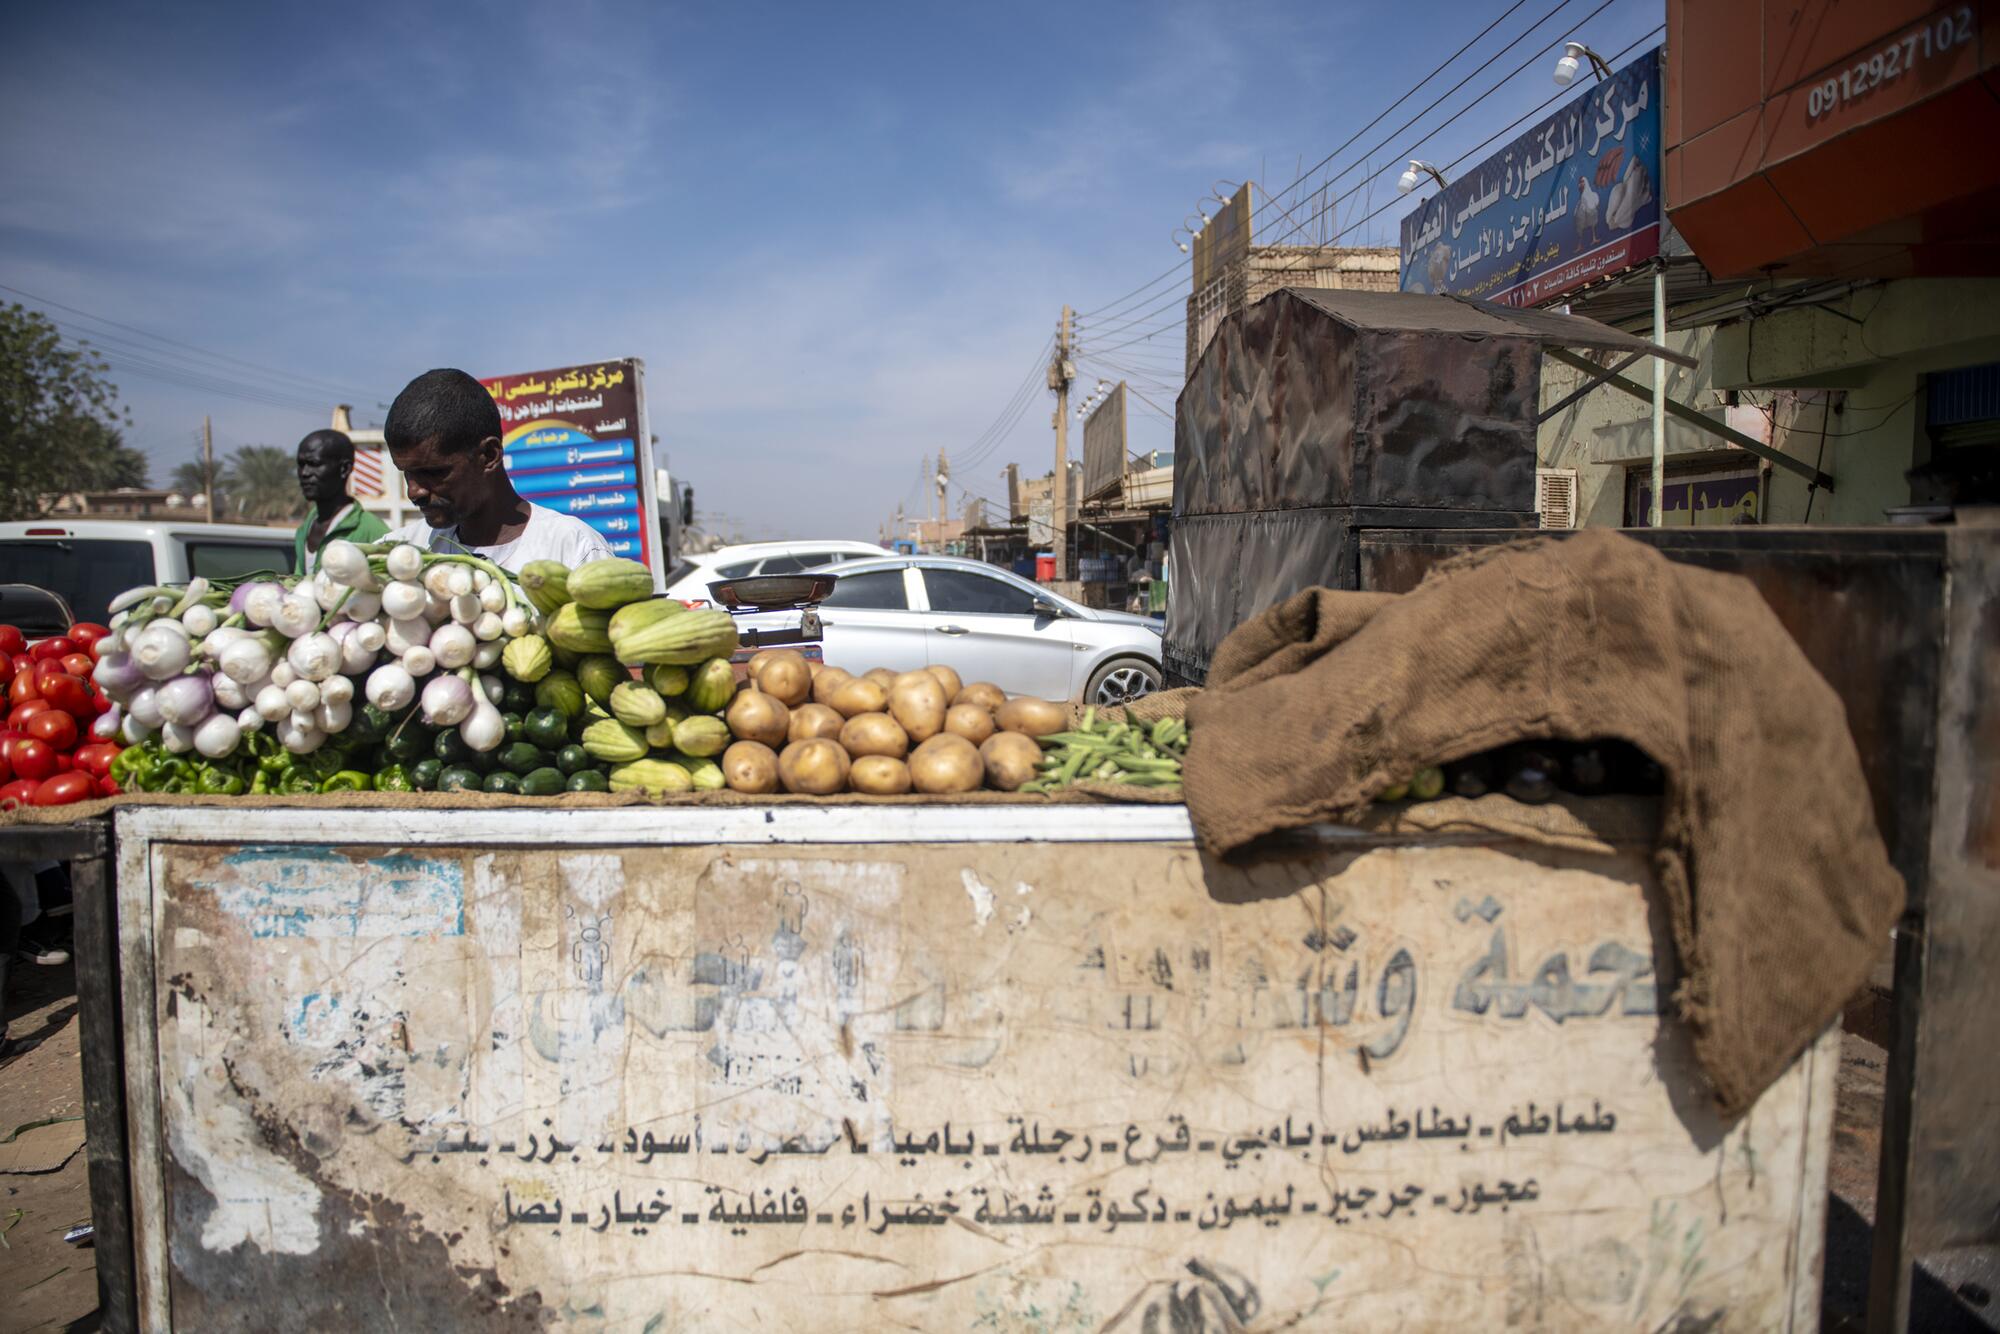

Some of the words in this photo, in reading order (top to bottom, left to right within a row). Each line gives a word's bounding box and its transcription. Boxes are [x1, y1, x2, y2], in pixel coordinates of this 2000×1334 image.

[1808, 7, 1972, 117] 0912927102
[1588, 80, 1648, 156] مركز
[1505, 113, 1584, 200] الدكتورة
[1452, 175, 1500, 239] سلمى
[1506, 185, 1568, 251] للدواجن
[505, 377, 546, 401] سلمى
[548, 370, 588, 396] دكتور
[590, 366, 625, 390] مركز
[513, 398, 554, 420] الدواجن
[555, 393, 603, 413] لمنتجات
[1007, 1115, 1092, 1164] رجلة
[1125, 1114, 1190, 1166] قرع
[1342, 1105, 1472, 1154] بطاطس
[1501, 1099, 1617, 1146] طماطم
[591, 1188, 672, 1235] خيار
[705, 1185, 808, 1236] فلفلية
[841, 1190, 961, 1235] خضراء
[971, 1184, 1056, 1224] شطة
[1087, 1187, 1167, 1233] دكوة
[1198, 1183, 1295, 1230] ليمون
[1325, 1185, 1423, 1225] جرجير
[1451, 1178, 1539, 1214] عجور
